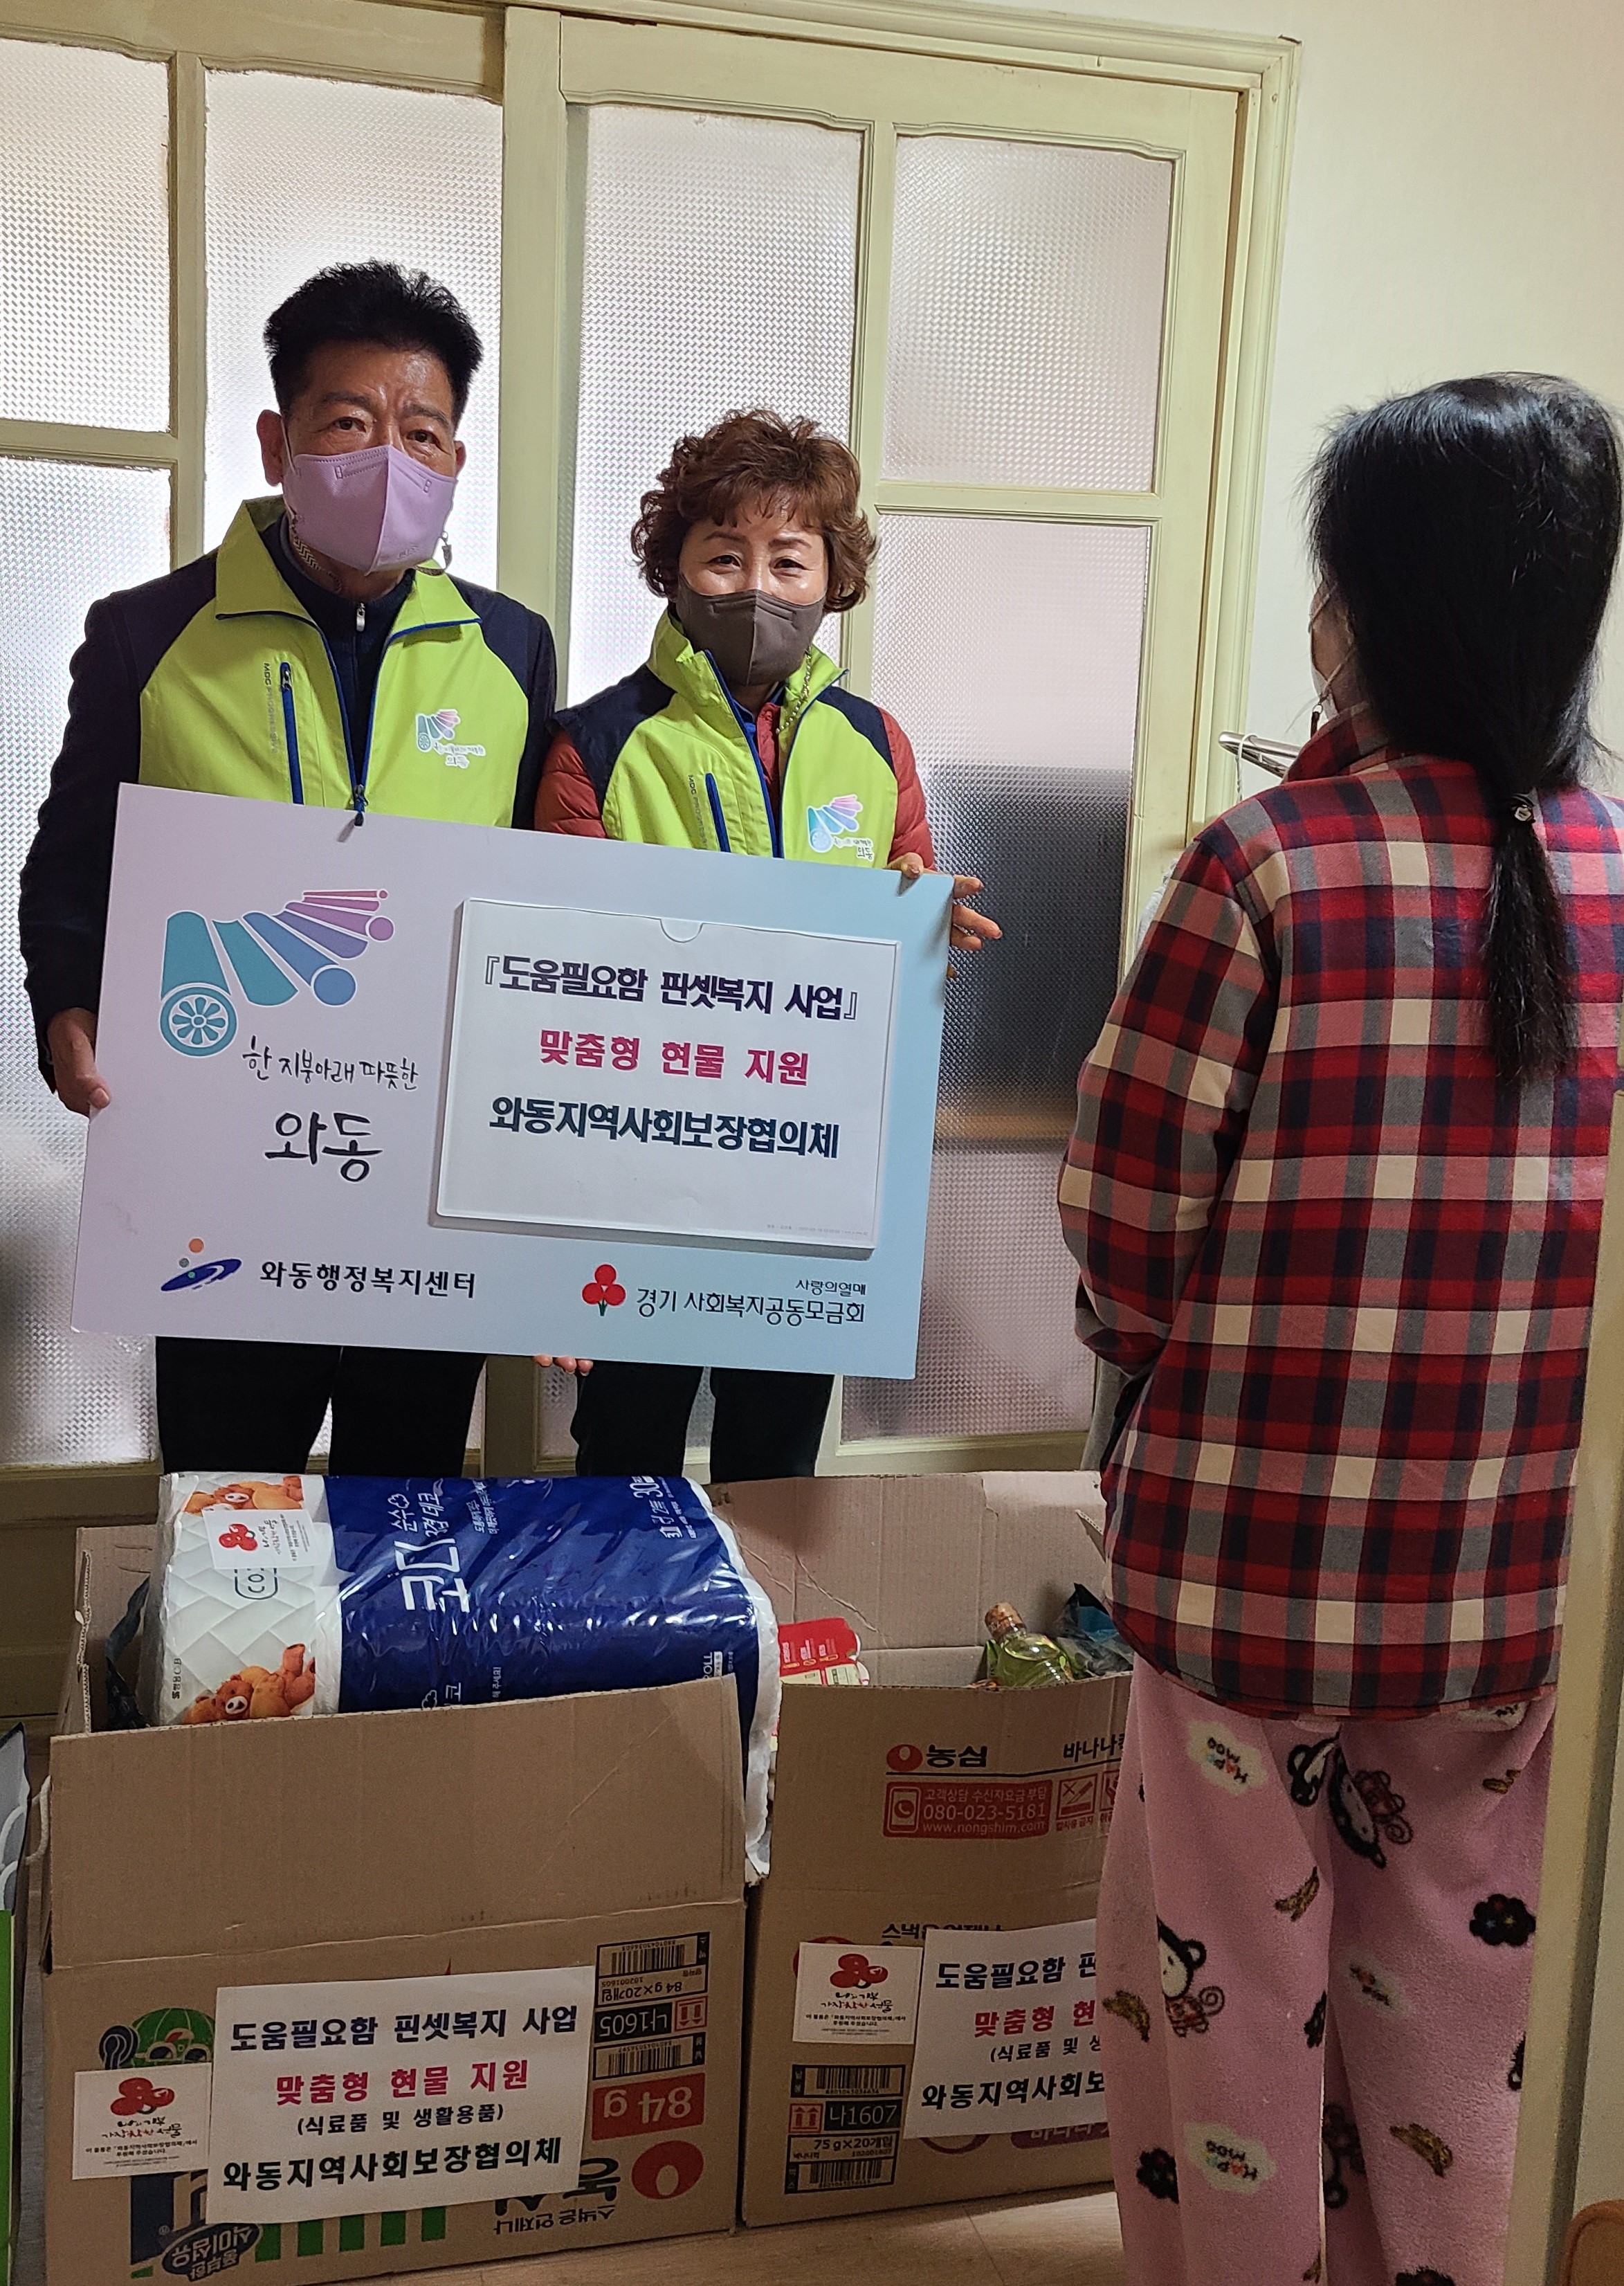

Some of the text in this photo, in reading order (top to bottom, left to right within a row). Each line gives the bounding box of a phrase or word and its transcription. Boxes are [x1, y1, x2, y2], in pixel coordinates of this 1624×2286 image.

[264, 662, 272, 685] MDC
[688, 774, 697, 795] MDC
[661, 971, 774, 1014] 핀셋복지
[243, 1035, 419, 1090] 한 지붕아래 따뜻한
[539, 1029, 809, 1085] 맞춤형 현물 지원
[489, 1096, 840, 1159] 와동지역사회보장협의체
[264, 1112, 382, 1181] 와동
[259, 1261, 476, 1298] 와동행정복지센터
[795, 1279, 866, 1297] 사랑의열매
[637, 1287, 865, 1327] 경기 사회복지공동모금회
[387, 1509, 418, 1532] 순수
[417, 1492, 445, 1516] 데코
[394, 1538, 471, 1613] 코디
[926, 1744, 987, 1768] 농심
[924, 1786, 1046, 1803] 고객상담 수신자요금 부담
[923, 1803, 1046, 1821] 080-023-5181
[923, 1820, 1046, 1834] www.nongshim.com
[666, 1981, 682, 1993] 84
[936, 1956, 1066, 1990] 도움필요함
[230, 2004, 577, 2052] 도움필요함 핀셋복지 사업
[599, 2008, 668, 2037] 나1605
[974, 1999, 1095, 2038] 맞춤형 현
[990, 2040, 1050, 2063] (식료품
[1063, 2038, 1078, 2055] 및
[275, 2059, 528, 2105] 맞춤형 현물 지원
[921, 2071, 1106, 2110] 와동지역사회보
[296, 2103, 504, 2138] (식료품 및 생활용품)
[603, 2087, 692, 2123] 84 g
[830, 2105, 897, 2127] 나1607
[814, 2139, 830, 2150] 75
[223, 2137, 562, 2193] 와동지역사회보장협의체
[493, 2205, 616, 2235] 스낵은 언제나
[172, 2226, 253, 2267] 식이섬유
[188, 2249, 238, 2280] 풍부한
